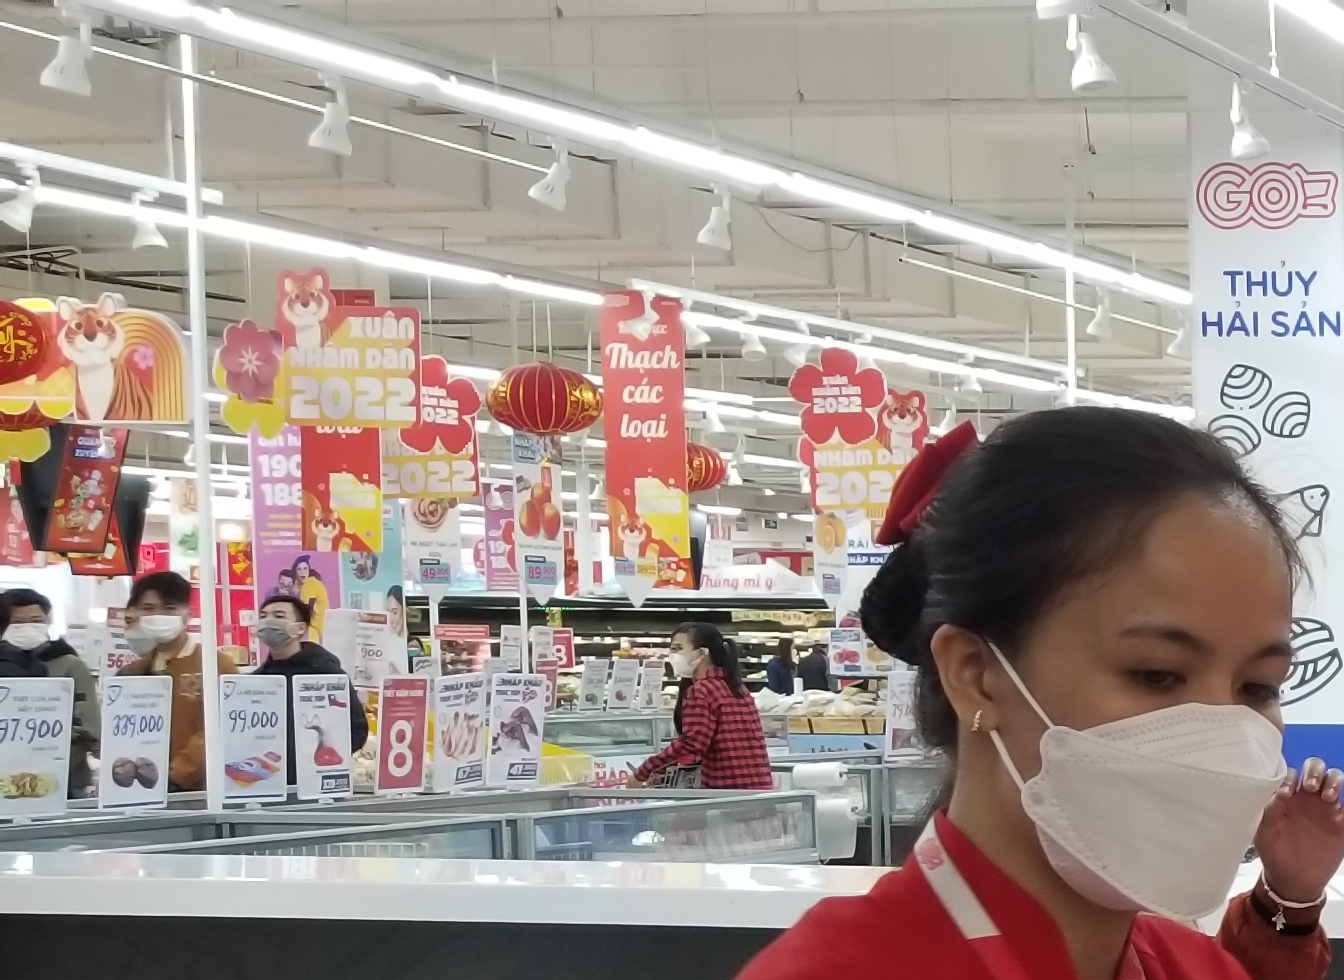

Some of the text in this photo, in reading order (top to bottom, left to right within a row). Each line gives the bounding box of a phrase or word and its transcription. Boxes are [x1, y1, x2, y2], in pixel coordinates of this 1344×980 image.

[1223, 261, 1317, 297] THỦY
[1201, 301, 1341, 337] HẢI SẢN
[605, 342, 681, 374] Thạch
[290, 375, 417, 422] 2022
[622, 377, 664, 404] các
[813, 396, 862, 414] 2022
[422, 407, 459, 426] 022
[620, 413, 669, 443] loại
[816, 470, 898, 506] 202
[229, 709, 278, 733] 99.000
[388, 719, 413, 777] 8
